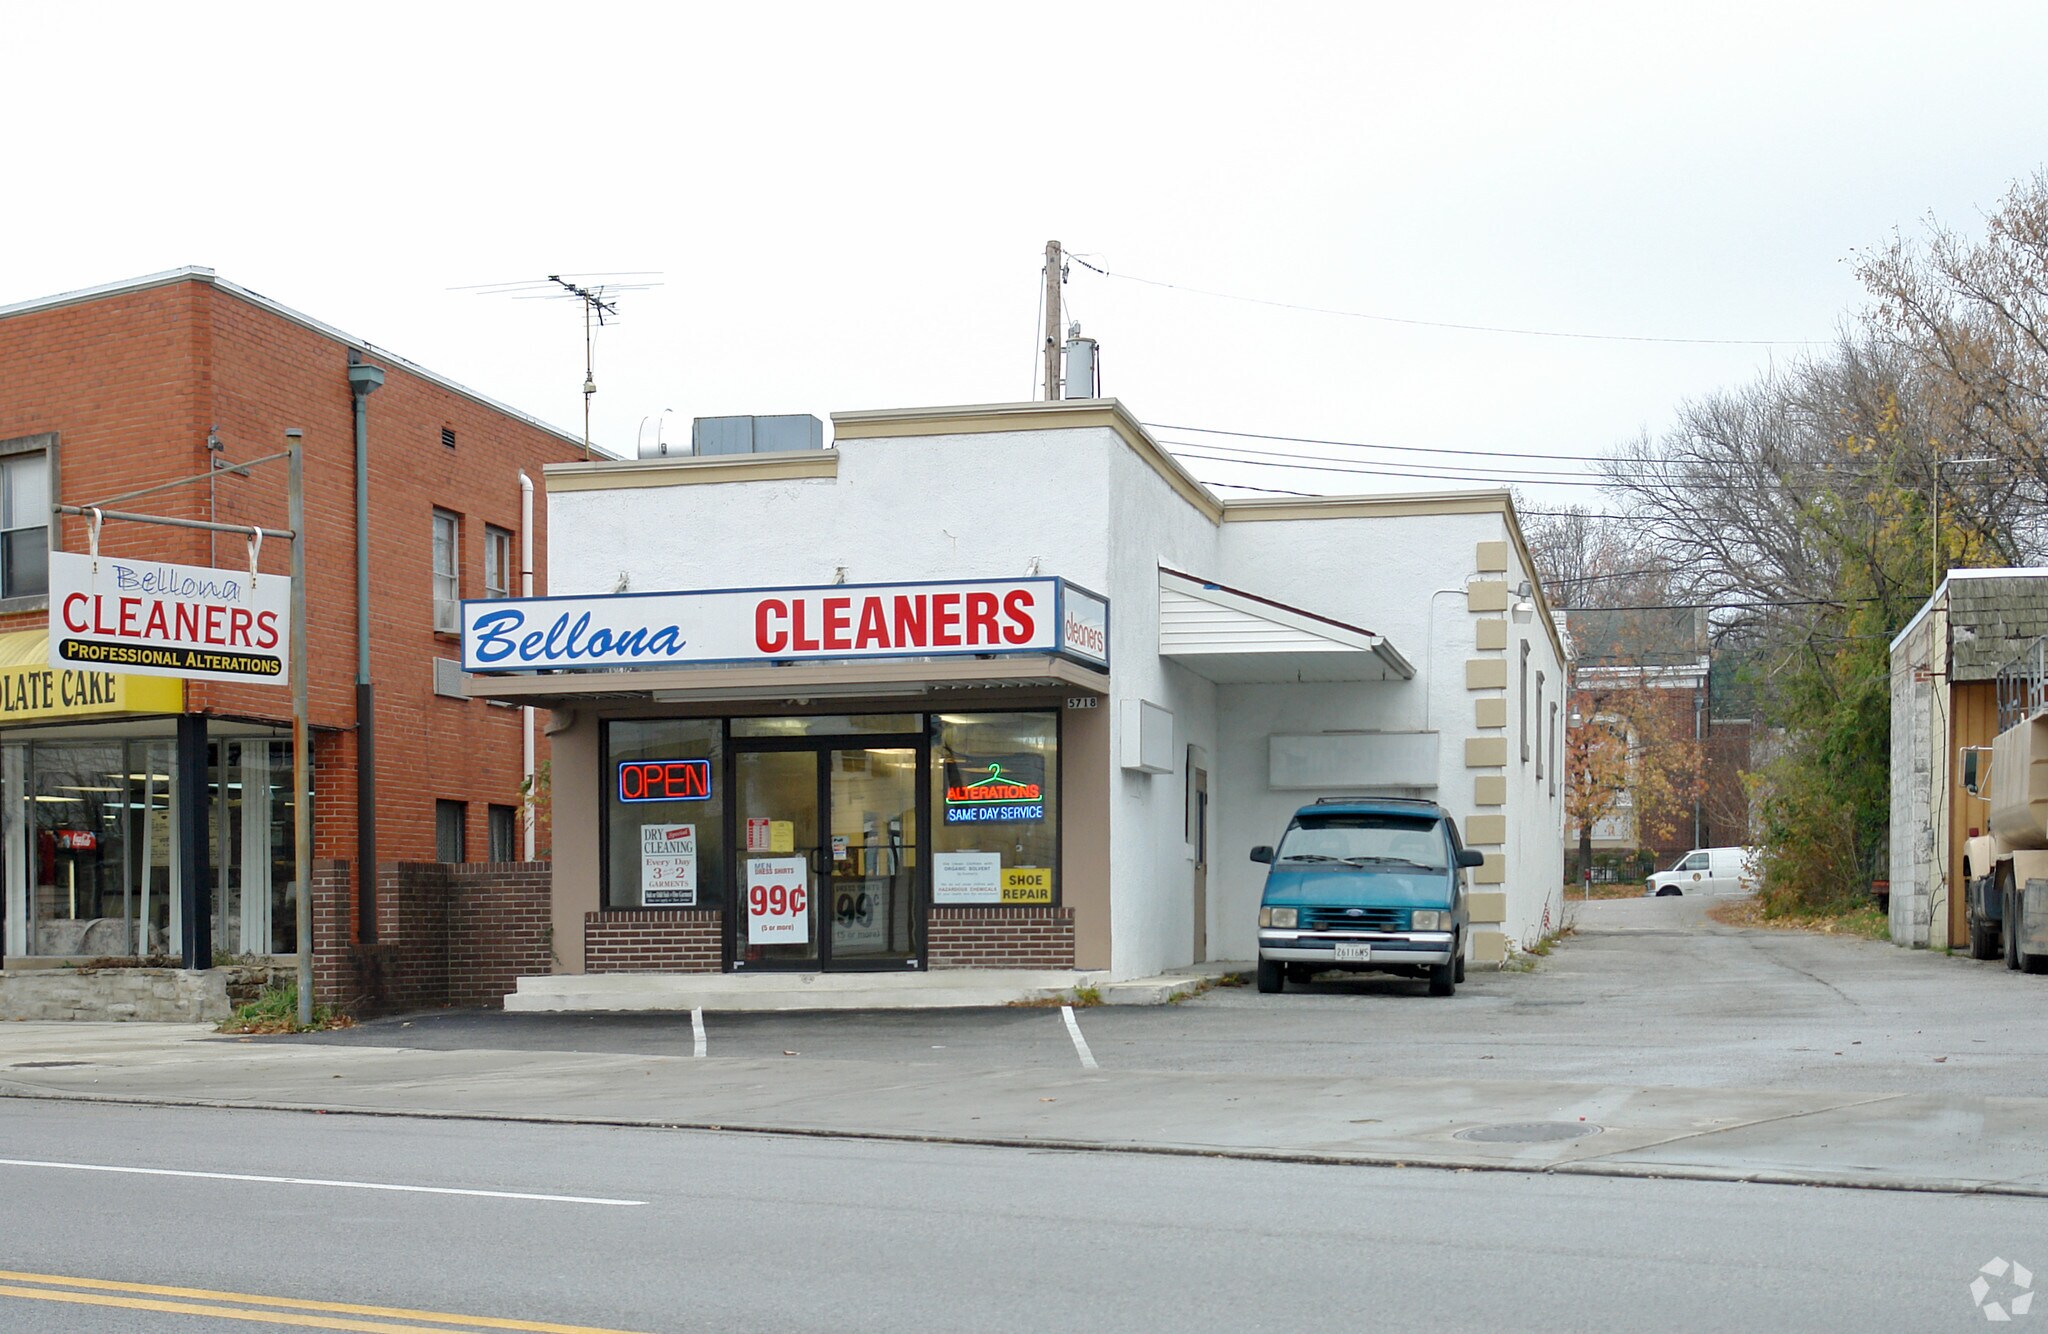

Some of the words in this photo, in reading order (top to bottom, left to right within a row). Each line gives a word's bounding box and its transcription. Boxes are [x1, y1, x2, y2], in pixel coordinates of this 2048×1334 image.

[112, 564, 240, 602] Bellona
[62, 591, 279, 650] CLEANERS
[472, 609, 687, 663] Bellona
[755, 589, 1035, 653] CLEANERS
[1065, 611, 1104, 653] cleaners
[0, 670, 54, 712] LATE
[61, 669, 116, 707] CAKE
[1069, 698, 1097, 708] 5718
[622, 763, 707, 798] OPEN
[947, 784, 1040, 801] ALTERATIONS
[949, 808, 978, 822] SAME
[980, 807, 1000, 820] DAY
[1001, 805, 1043, 820] SERVICE
[644, 828, 663, 841] DRY
[644, 841, 693, 854] CLEANING
[646, 858, 670, 867] Every
[674, 858, 691, 866] Day
[652, 867, 662, 879] 3
[675, 867, 685, 878] 2
[774, 867, 795, 875] SHIRTS
[648, 880, 689, 888] GARMENTS
[1009, 875, 1043, 886] SHOE
[750, 884, 806, 917] 99¢
[1003, 889, 1048, 899] REPAIR
[776, 923, 795, 931] more)
